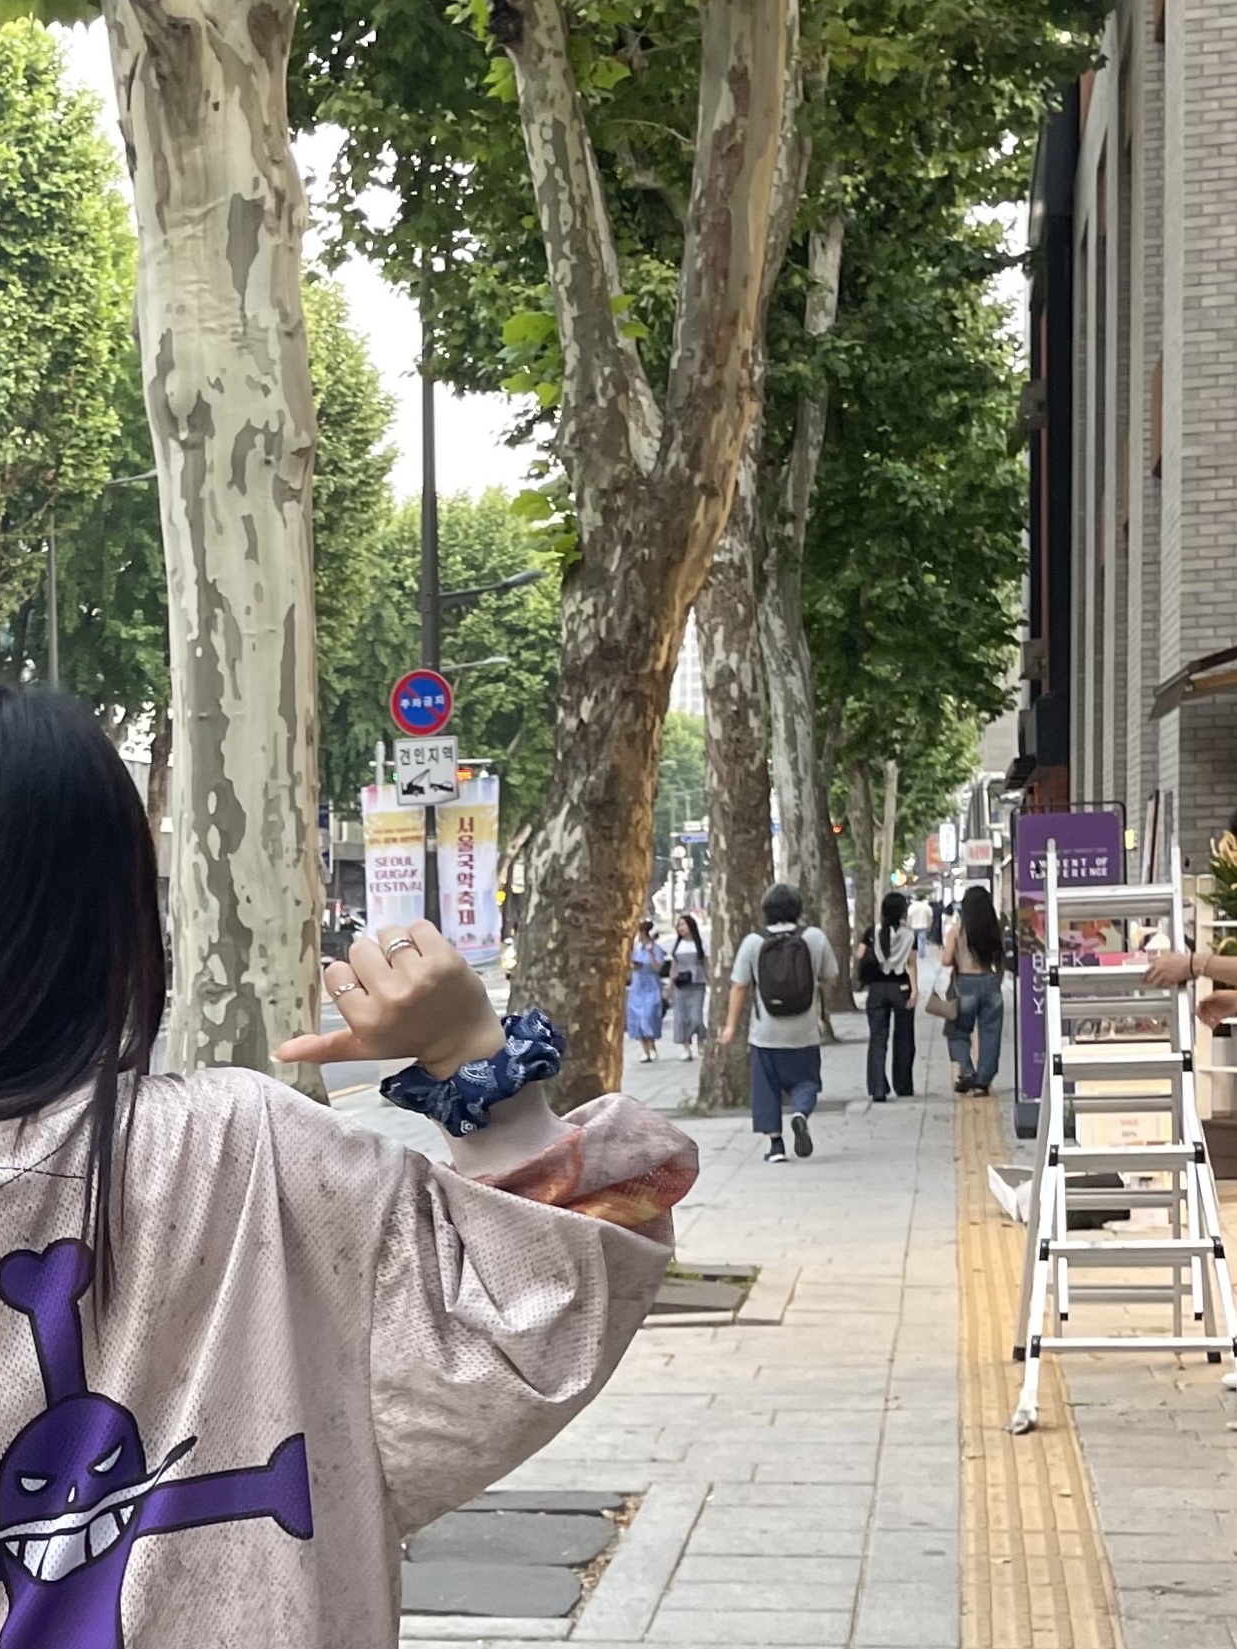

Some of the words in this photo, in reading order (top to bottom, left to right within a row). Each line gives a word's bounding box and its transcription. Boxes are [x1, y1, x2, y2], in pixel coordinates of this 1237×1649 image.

[400, 694, 445, 709] 주차금지
[399, 746, 453, 766] 견인지역
[375, 856, 415, 867] SEOUL
[1095, 856, 1109, 867] OF
[375, 868, 419, 879] GUGAK
[456, 816, 476, 926] 서울국악축제
[369, 881, 423, 893] FESTIVAL
